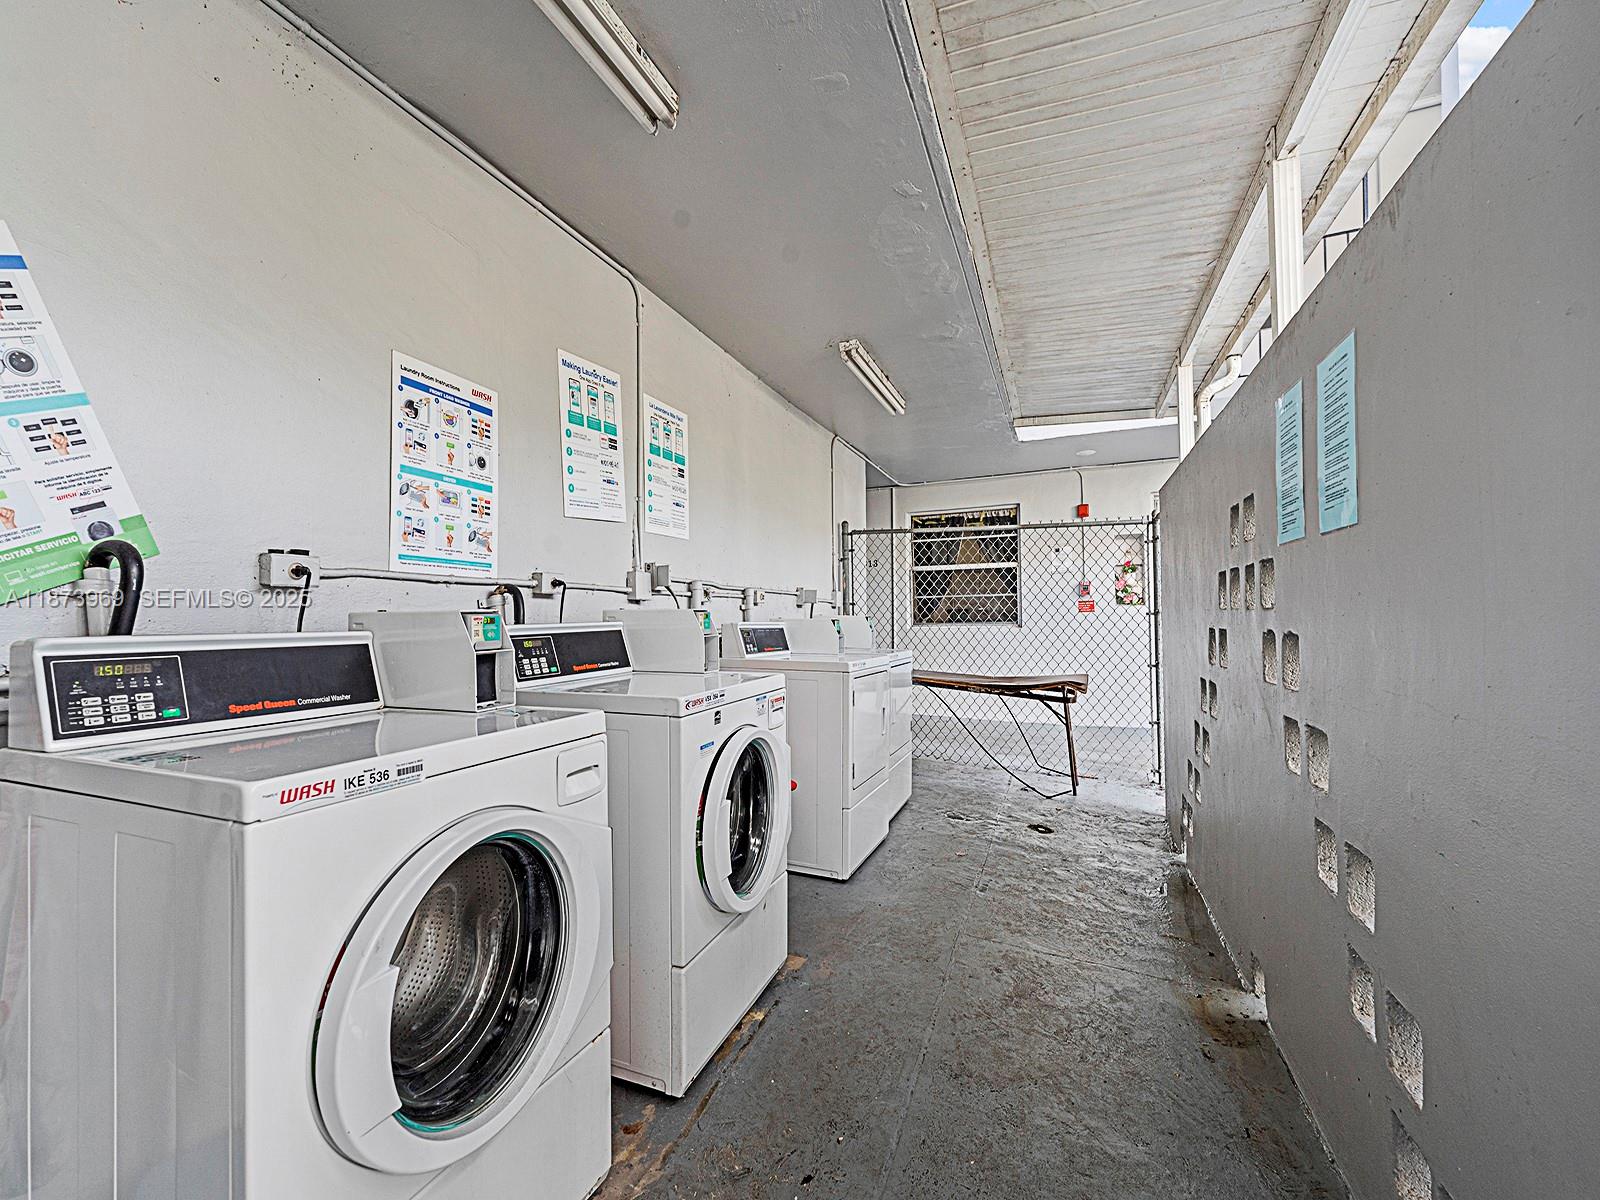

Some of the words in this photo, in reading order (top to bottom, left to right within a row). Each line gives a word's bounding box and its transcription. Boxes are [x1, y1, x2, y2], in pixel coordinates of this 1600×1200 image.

[400, 364, 420, 377] Laundry
[420, 372, 435, 382] Room
[435, 378, 461, 392] Instructions
[561, 358, 581, 374] Making
[582, 366, 602, 382] Laundry
[471, 388, 492, 403] WASH
[57, 492, 77, 501] WASH
[0, 548, 34, 563] ICITAR
[35, 535, 79, 552] SERVICIO
[228, 701, 263, 714] Speed
[264, 699, 296, 709] Queen
[297, 695, 330, 706] Commercial
[331, 693, 351, 702] Washer
[279, 779, 335, 804] WASH
[344, 774, 365, 791] IKE
[369, 769, 390, 785] 536
